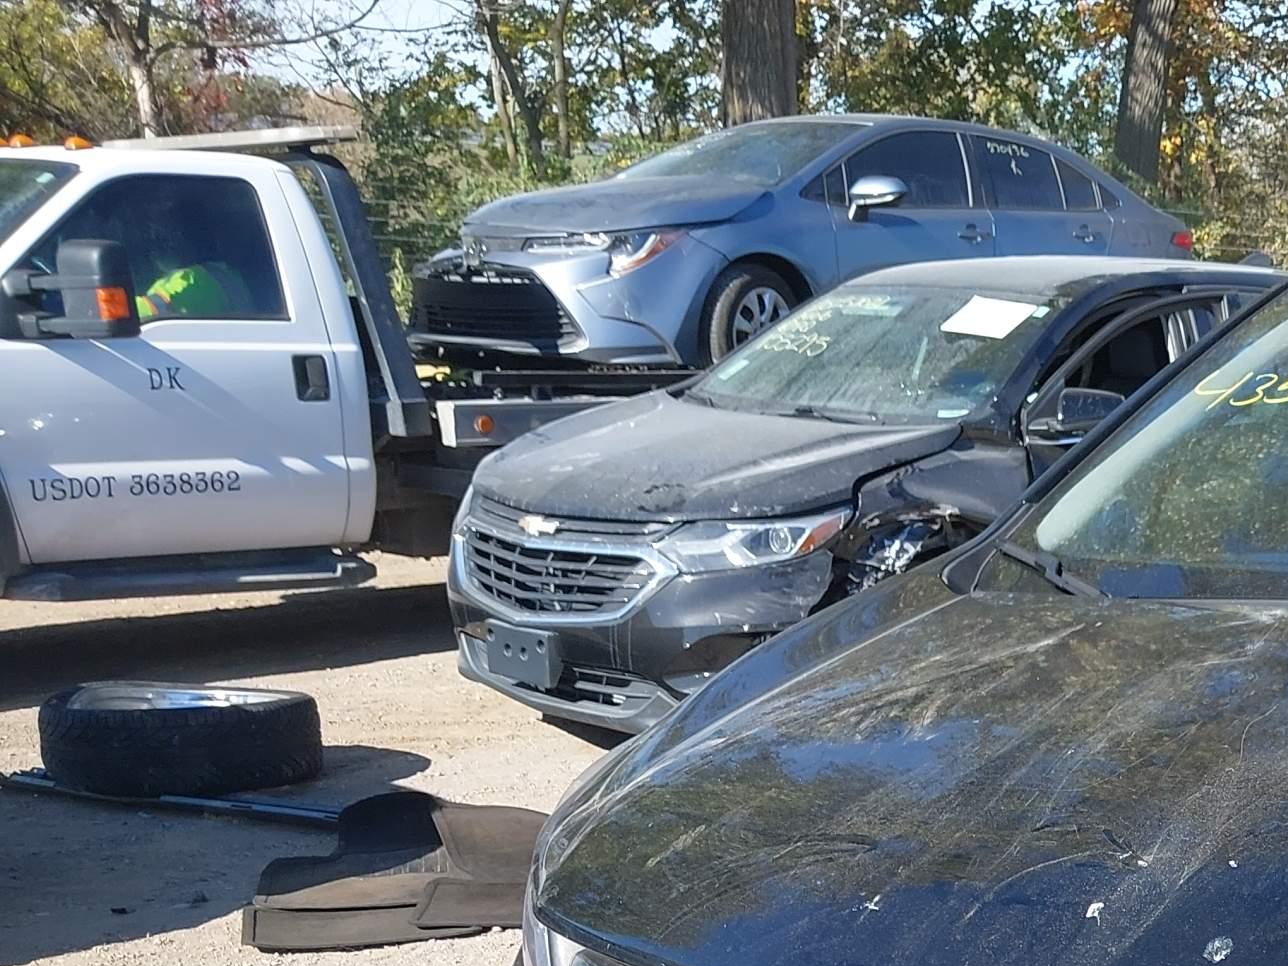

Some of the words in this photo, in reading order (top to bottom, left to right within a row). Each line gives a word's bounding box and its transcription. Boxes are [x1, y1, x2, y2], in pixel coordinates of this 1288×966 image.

[147, 367, 185, 391] DK
[29, 476, 117, 502] USDOT
[129, 470, 242, 496] 3638362
